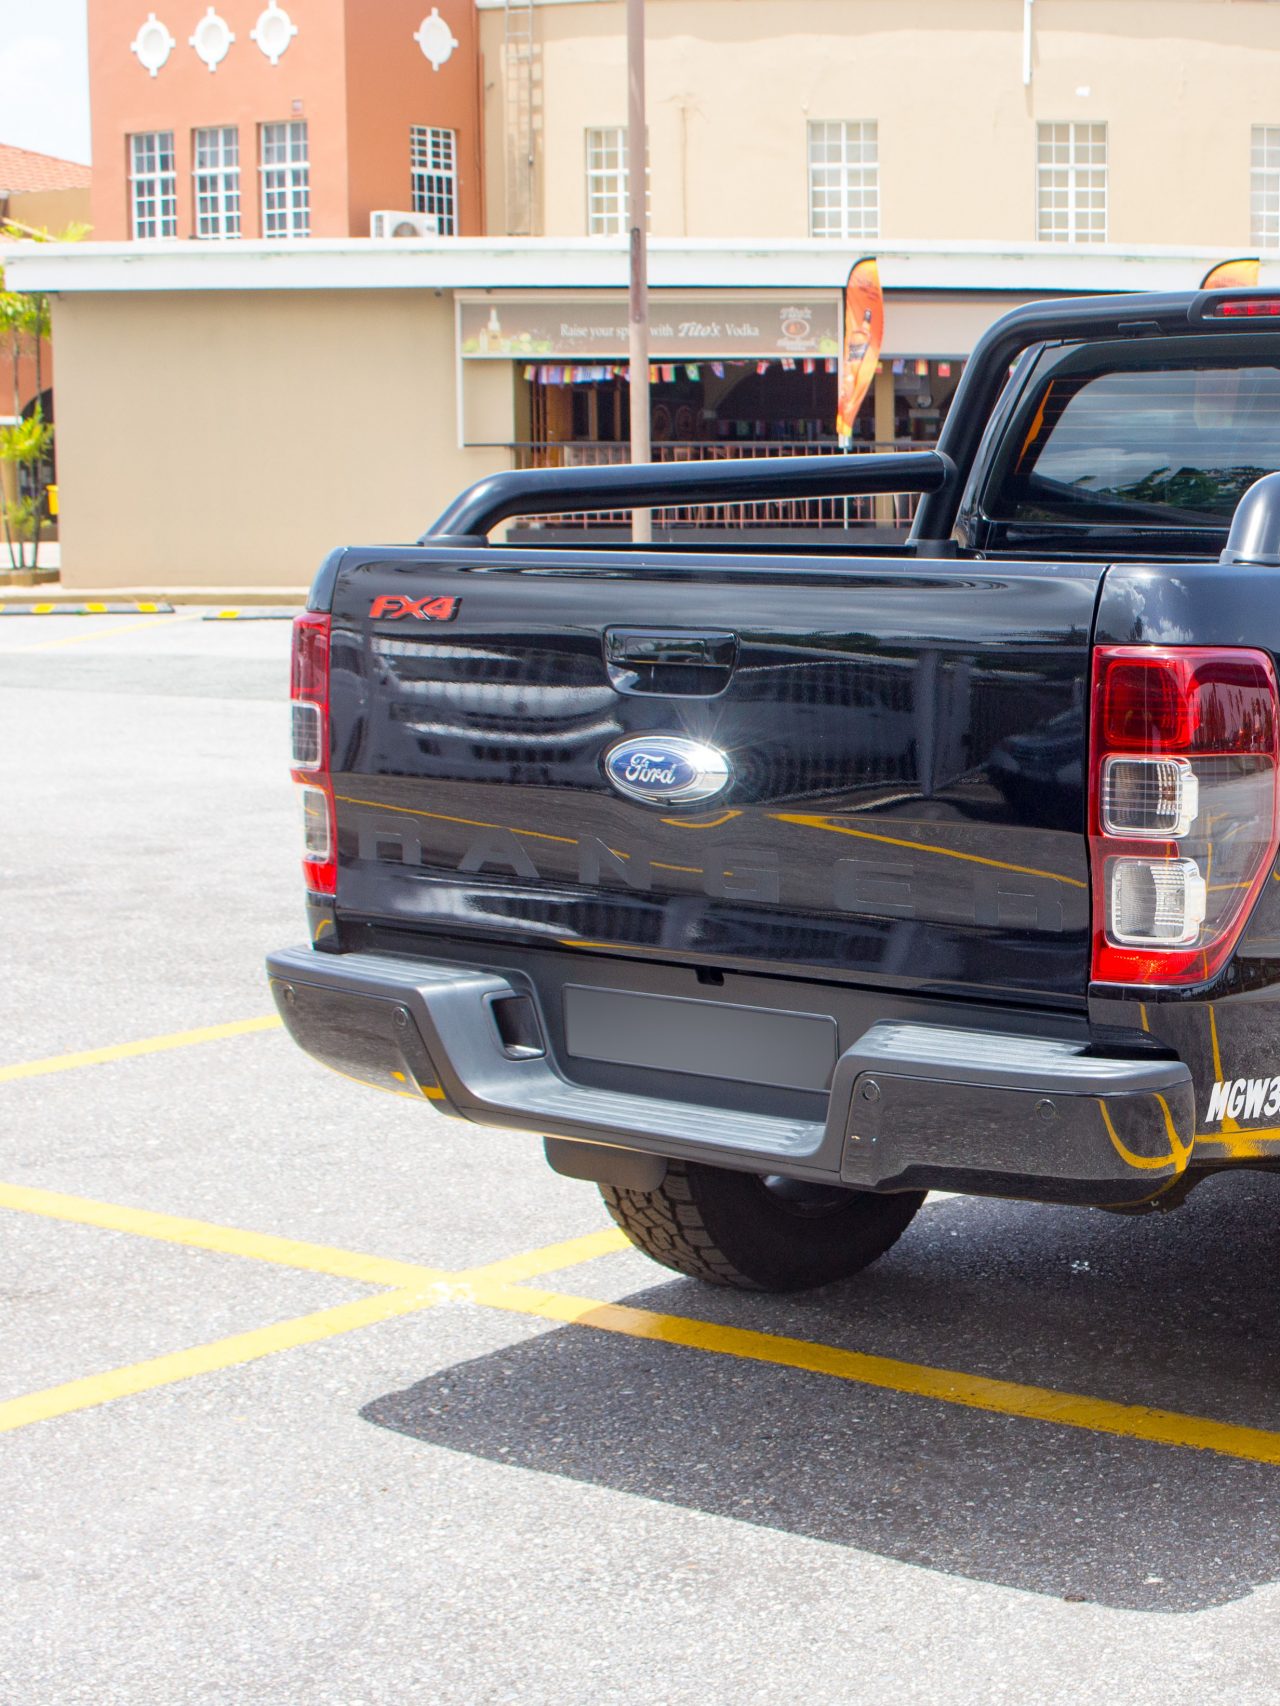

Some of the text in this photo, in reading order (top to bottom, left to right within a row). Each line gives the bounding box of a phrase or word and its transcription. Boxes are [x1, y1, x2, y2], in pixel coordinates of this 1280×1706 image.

[560, 323, 588, 337] Raise
[590, 326, 614, 340] your
[650, 323, 674, 337] with
[678, 322, 720, 337] Tito's
[724, 323, 760, 337] Vodka
[368, 594, 462, 621] FX4
[625, 753, 676, 784] Ford
[356, 814, 1064, 931] RANGER
